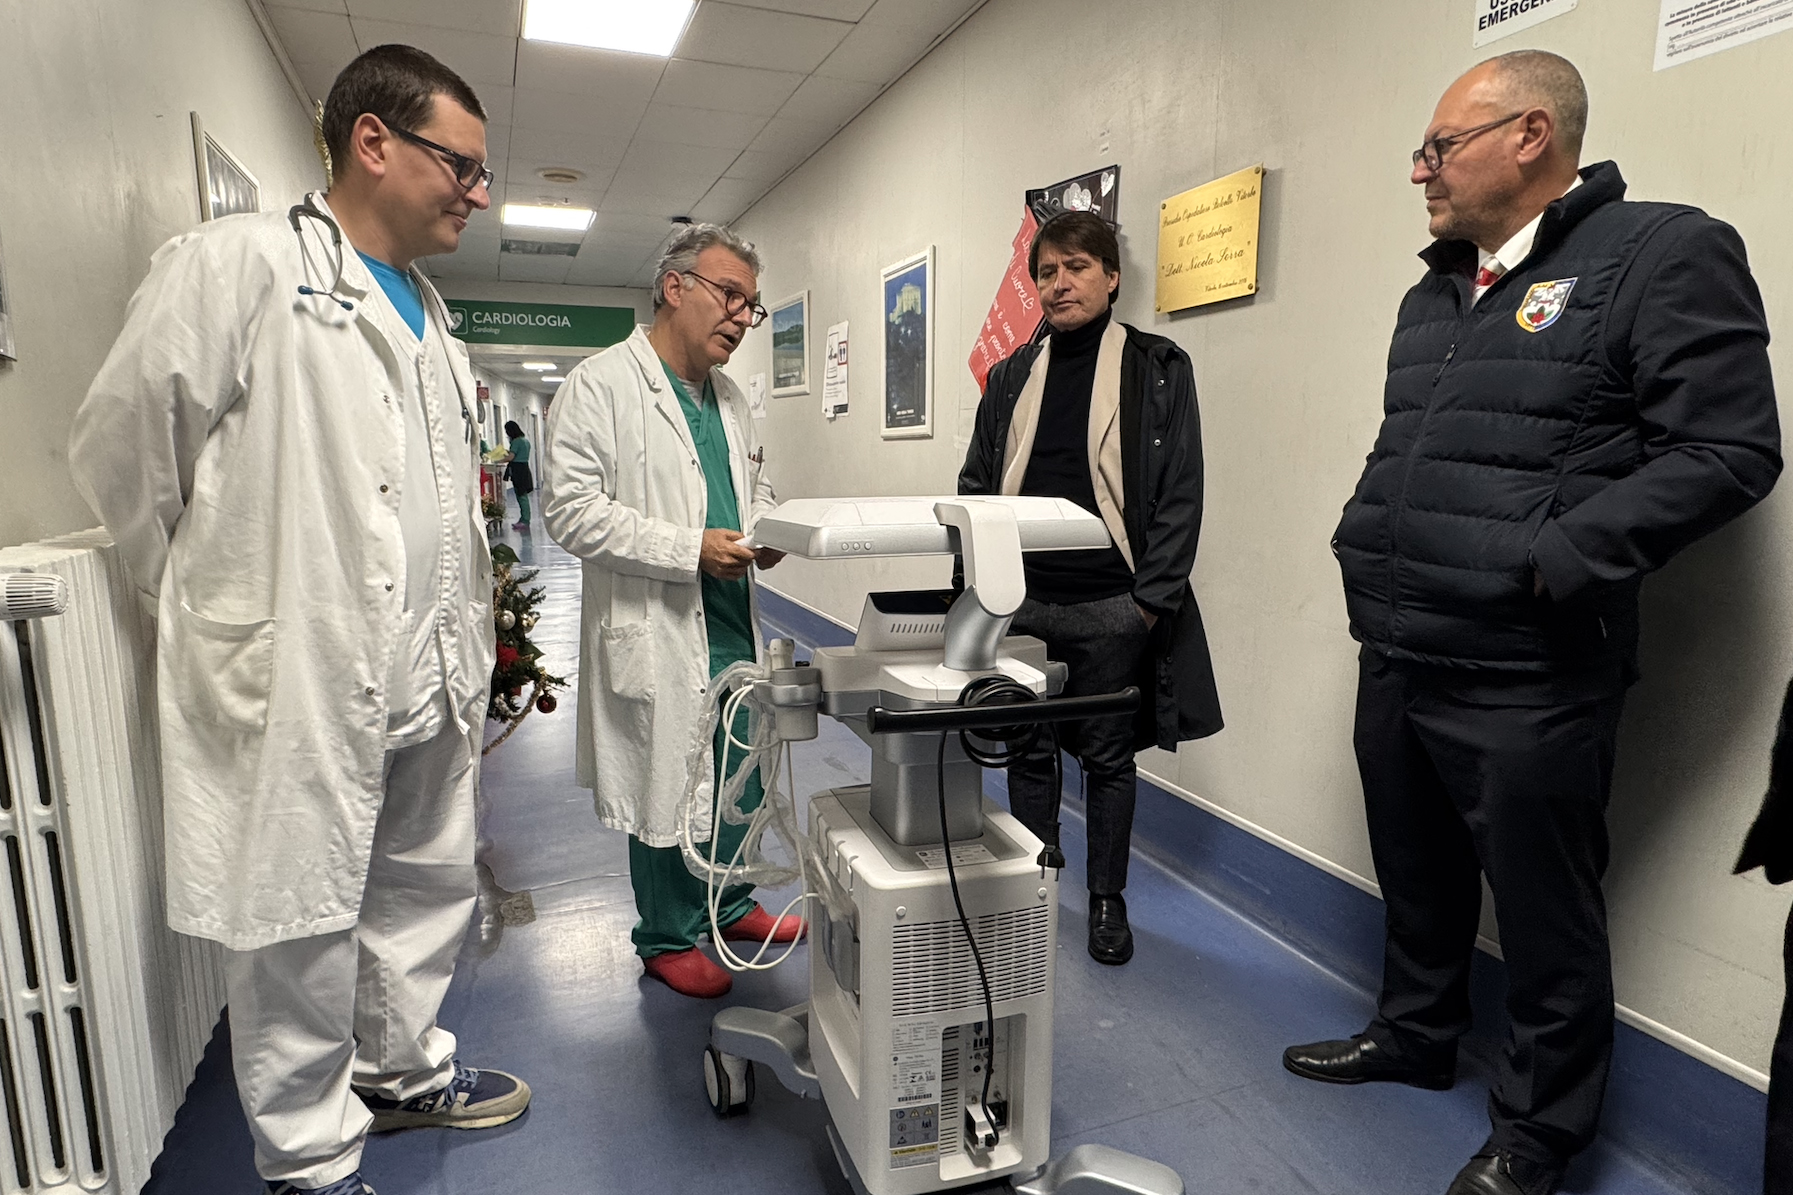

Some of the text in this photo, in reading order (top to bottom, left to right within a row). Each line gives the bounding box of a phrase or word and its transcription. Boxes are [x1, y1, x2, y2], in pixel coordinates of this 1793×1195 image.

[1197, 224, 1233, 242] Cardiologia
[1186, 252, 1214, 272] Nicola
[472, 311, 571, 328] CARDIOLOGIA
[472, 326, 501, 335] Cardiology
